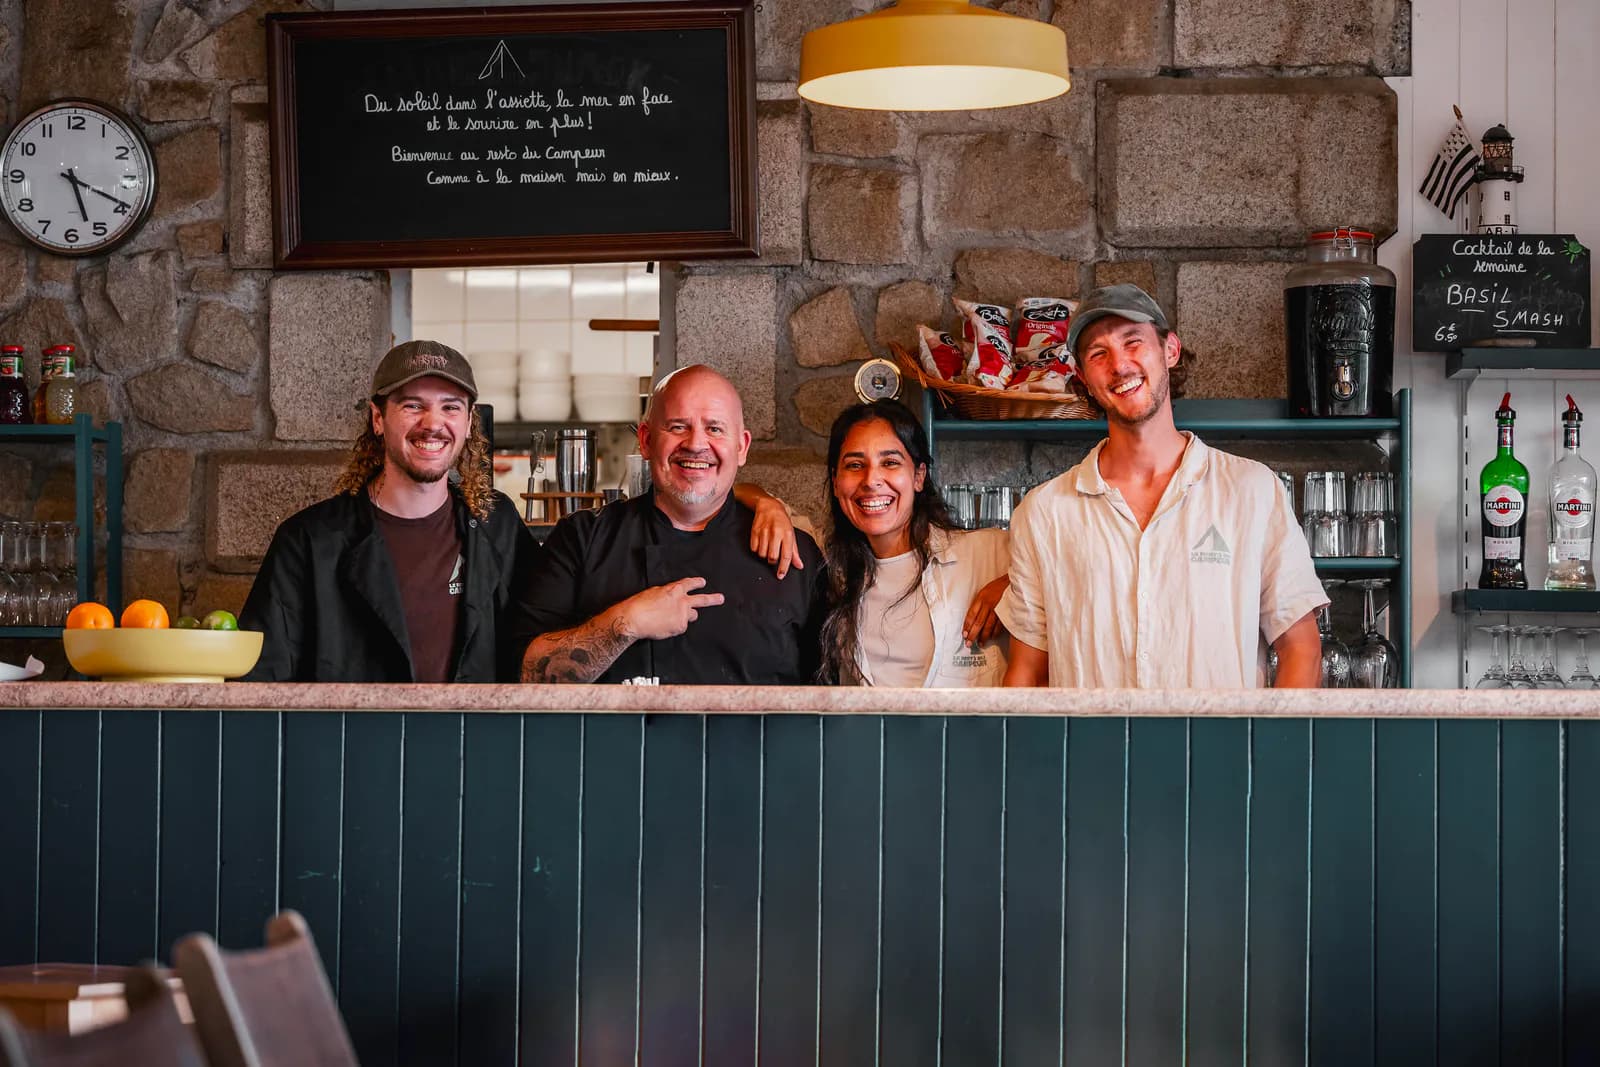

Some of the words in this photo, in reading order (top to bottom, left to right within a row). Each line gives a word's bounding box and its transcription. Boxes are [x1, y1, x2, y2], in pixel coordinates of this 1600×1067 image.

[365, 94, 393, 113] Du
[396, 90, 442, 112] soleil
[445, 95, 477, 111] dans
[556, 88, 575, 108] la
[579, 95, 613, 107] mer
[618, 94, 636, 107] en
[641, 86, 673, 116] face
[42, 123, 53, 138] 11
[67, 115, 86, 131] 12
[101, 123, 106, 138] 1
[426, 115, 441, 132] et
[447, 114, 461, 131] le
[464, 117, 519, 131] sourire
[525, 118, 544, 130] en
[21, 142, 37, 157] 10
[115, 146, 130, 161] 2
[391, 145, 455, 162] Bienvenue
[460, 151, 480, 161] au
[486, 145, 518, 161] resto
[522, 145, 542, 160] du
[545, 146, 606, 169] Campeur
[10, 169, 25, 184] 9
[426, 170, 471, 185] Comme
[476, 169, 490, 184] à
[495, 167, 513, 184] la
[519, 169, 567, 184] maison
[575, 167, 607, 183] mais
[612, 171, 627, 183] en
[633, 168, 679, 183] mieux.
[17, 198, 34, 213] 8
[38, 219, 52, 235] 7
[92, 222, 108, 236] 5
[64, 228, 80, 244] 6
[1452, 238, 1514, 256] Cocktail
[1517, 241, 1533, 256] de
[1536, 240, 1555, 256] la
[1472, 259, 1527, 274] semaine
[1492, 310, 1564, 328] SMASH
[1487, 501, 1520, 510] MARTINI
[1557, 503, 1591, 512] MARTINI
